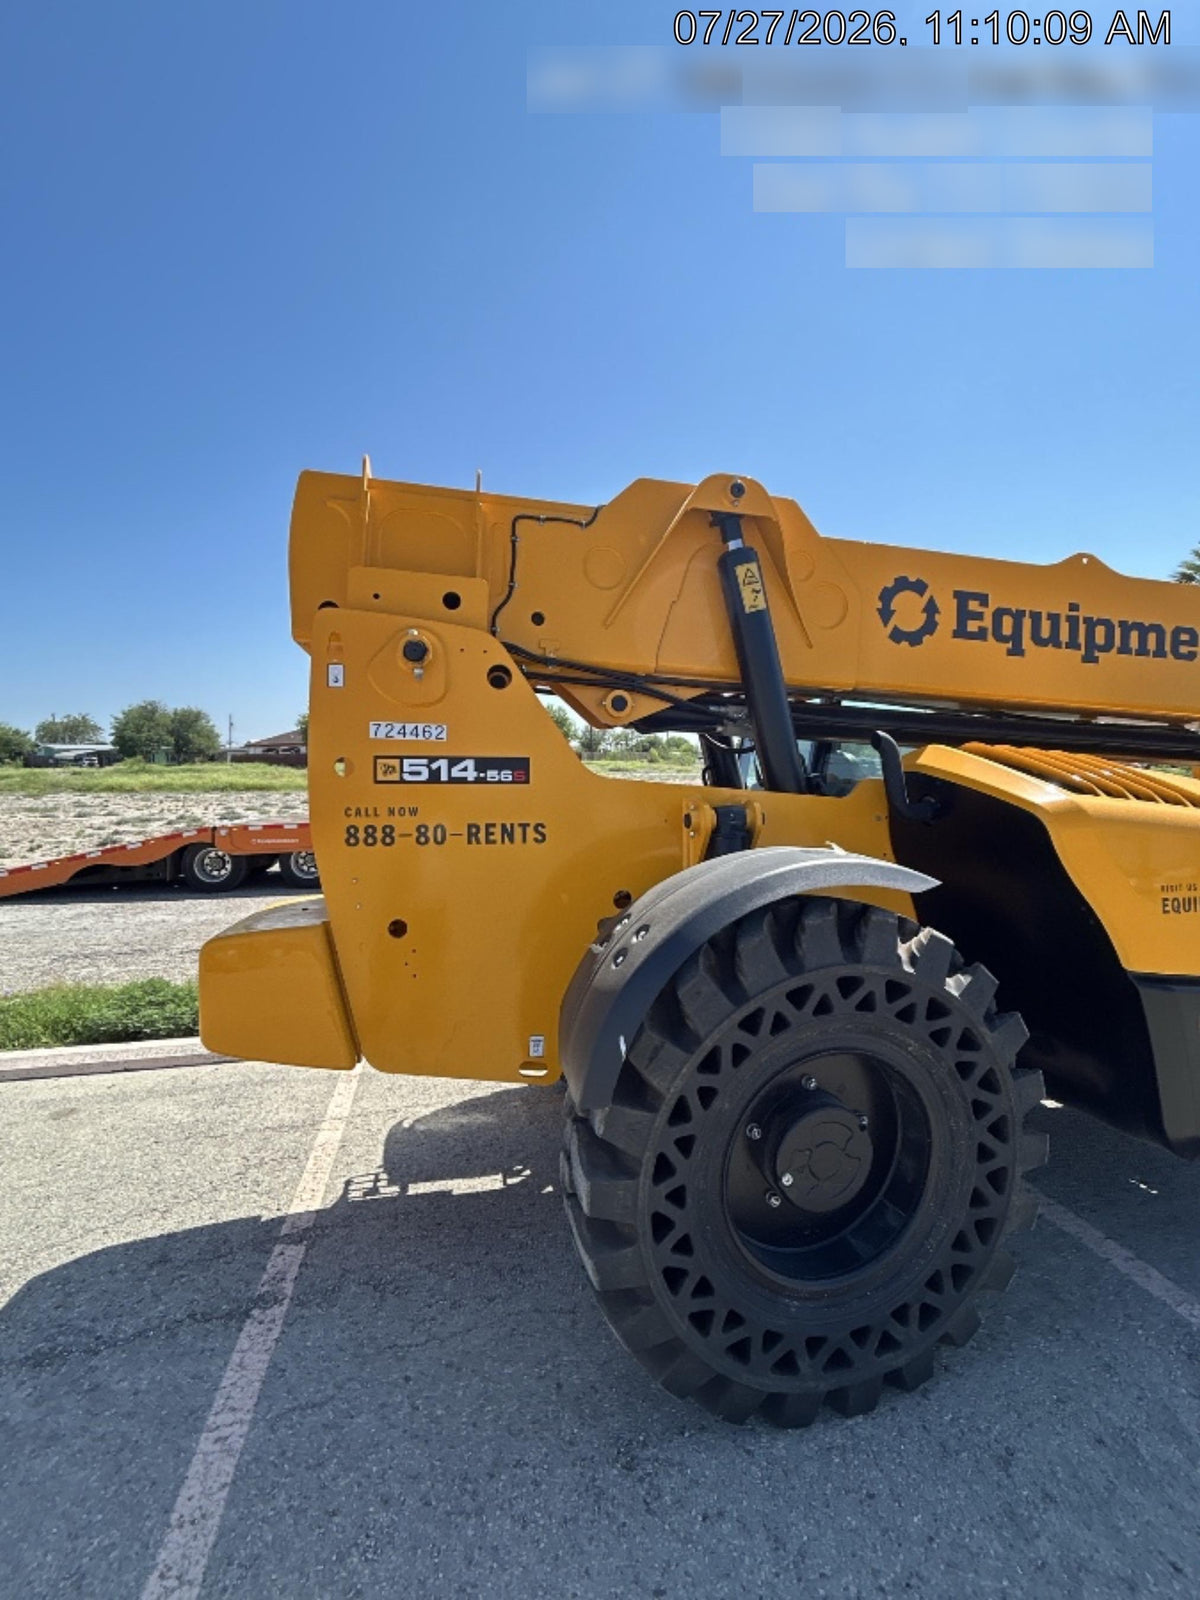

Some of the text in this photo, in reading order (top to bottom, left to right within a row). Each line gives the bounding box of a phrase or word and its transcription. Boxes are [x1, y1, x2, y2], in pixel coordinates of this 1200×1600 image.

[952, 589, 1199, 664] Equipme
[372, 723, 446, 740] 724462
[344, 806, 419, 818] CALL NOW
[344, 822, 547, 847] 888-80-RENTS
[1161, 897, 1198, 914] EQUI
